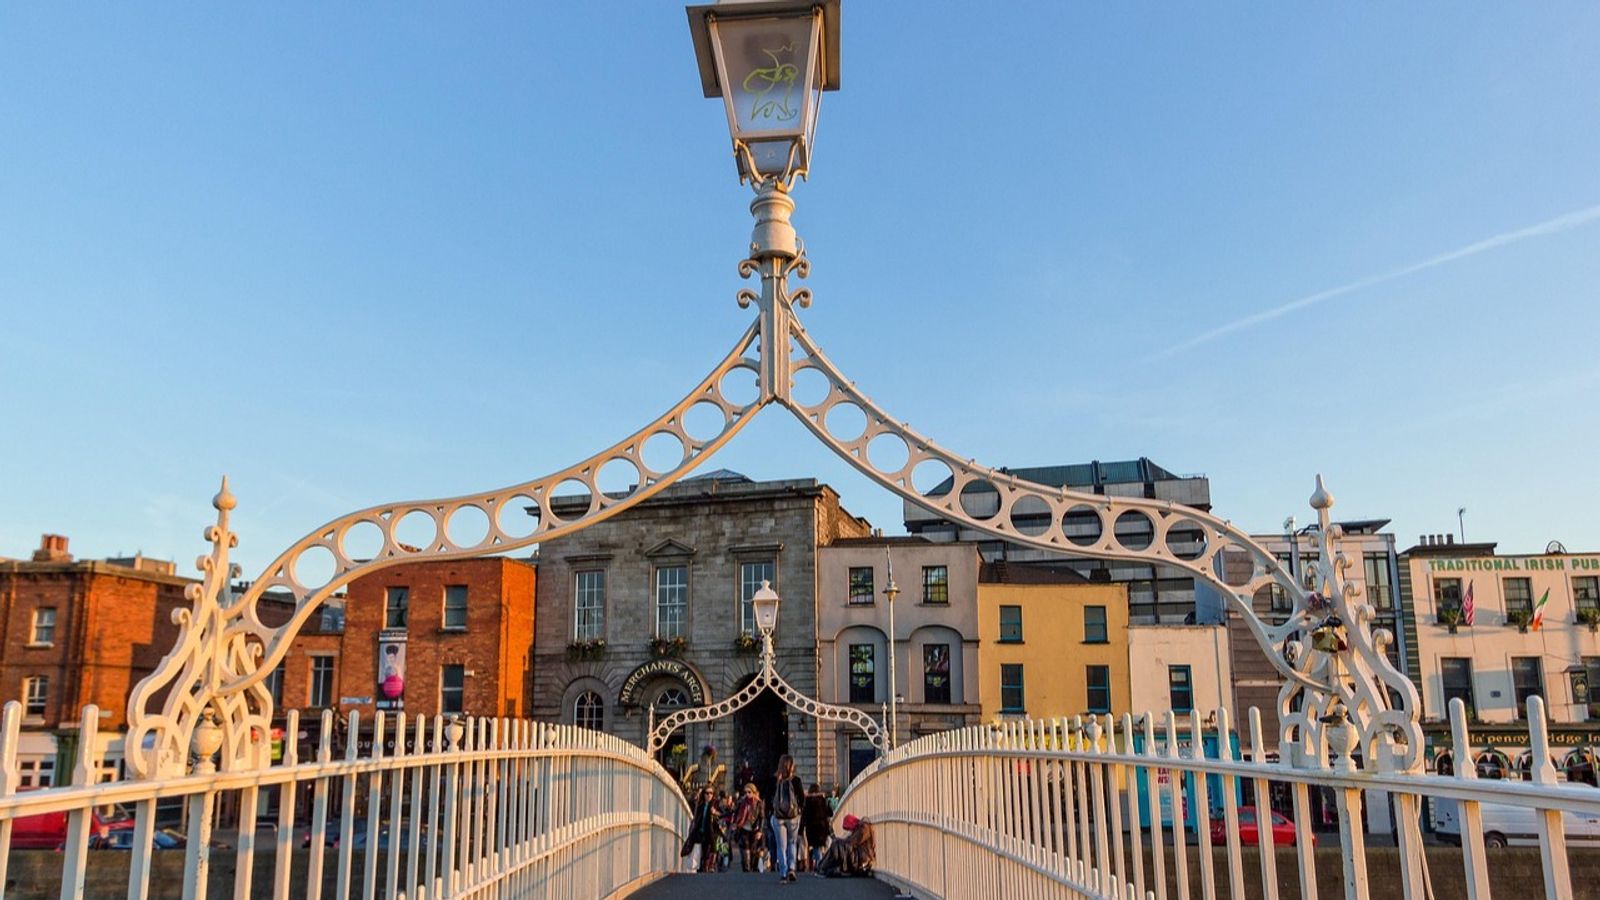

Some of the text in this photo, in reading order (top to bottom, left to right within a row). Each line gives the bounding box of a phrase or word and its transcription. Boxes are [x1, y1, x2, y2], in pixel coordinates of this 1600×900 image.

[1429, 558, 1600, 571] TRADITIONAL IRISH PUB
[621, 661, 702, 703] MERCHANTS ARCH
